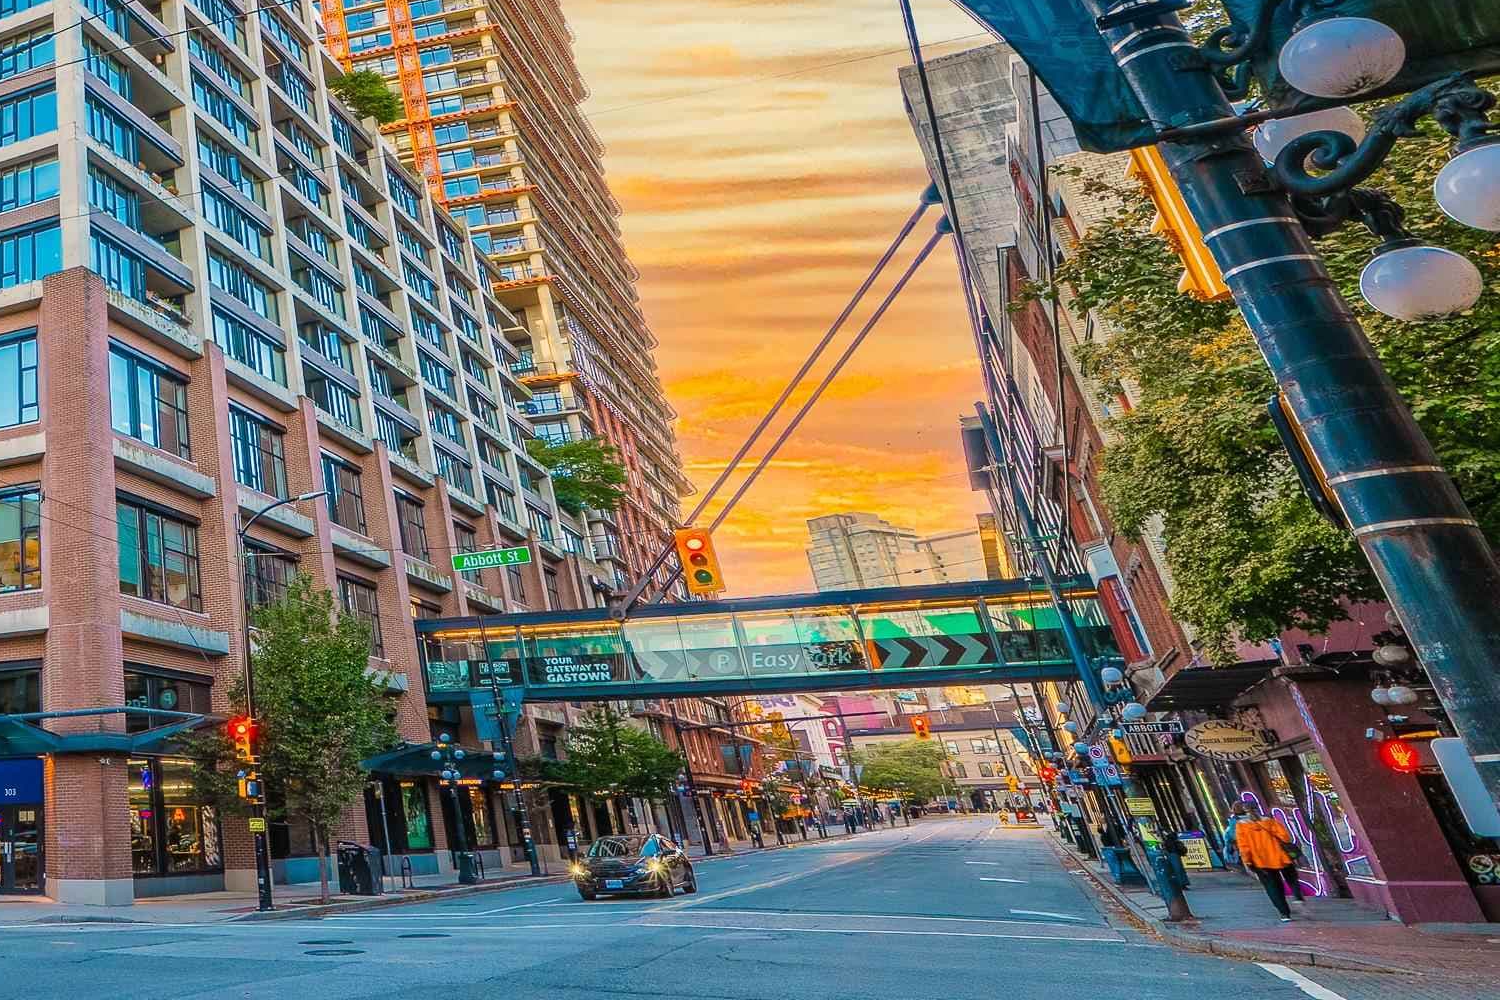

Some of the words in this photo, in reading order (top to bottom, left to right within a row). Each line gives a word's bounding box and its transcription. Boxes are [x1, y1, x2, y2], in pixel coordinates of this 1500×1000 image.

[463, 553, 502, 567] Abbott
[507, 551, 520, 562] St
[544, 657, 573, 665] YOUR
[752, 651, 800, 670] Easy
[546, 664, 591, 673] GATEWAY
[593, 663, 609, 671] TO
[547, 672, 611, 683] GASTOWN
[1129, 724, 1163, 733] ABBOTT
[4, 788, 17, 797] 303
